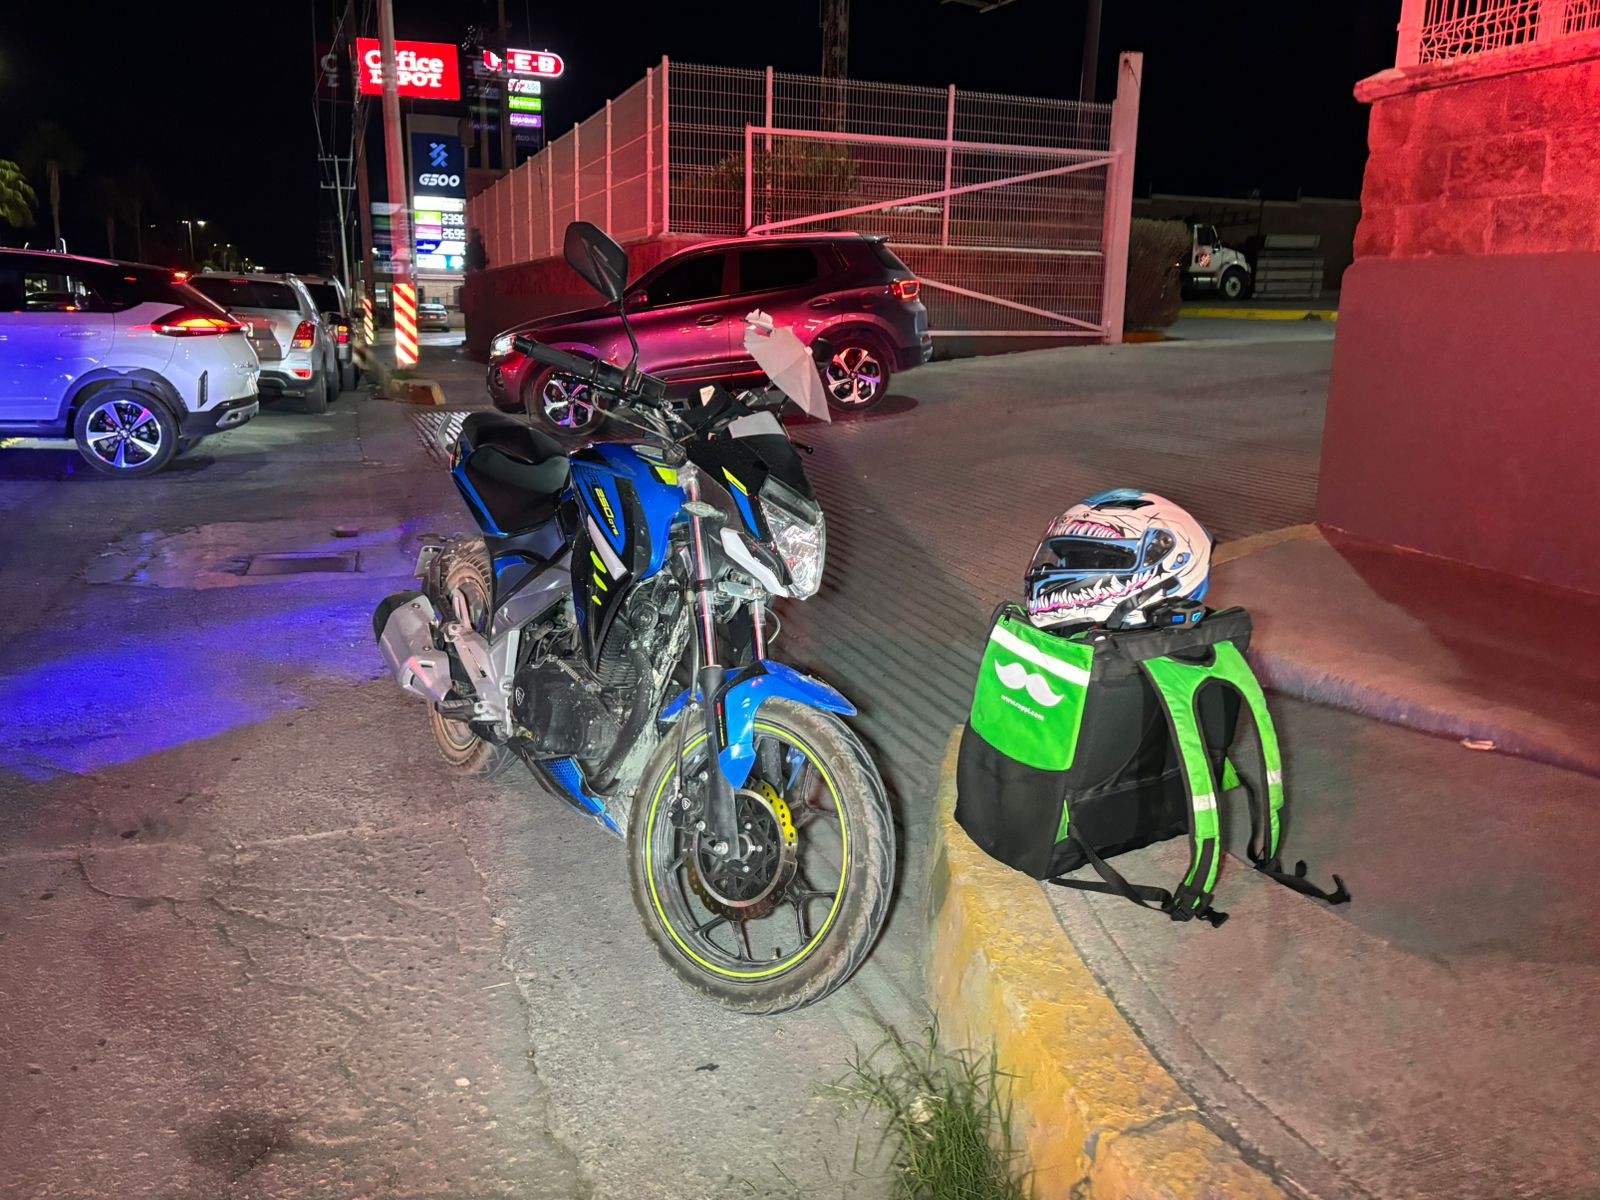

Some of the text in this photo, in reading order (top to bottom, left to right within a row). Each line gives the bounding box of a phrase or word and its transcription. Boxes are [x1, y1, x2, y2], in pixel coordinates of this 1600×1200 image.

[365, 49, 444, 73] Ofice
[369, 69, 442, 88] DPOT
[419, 173, 460, 187] G500
